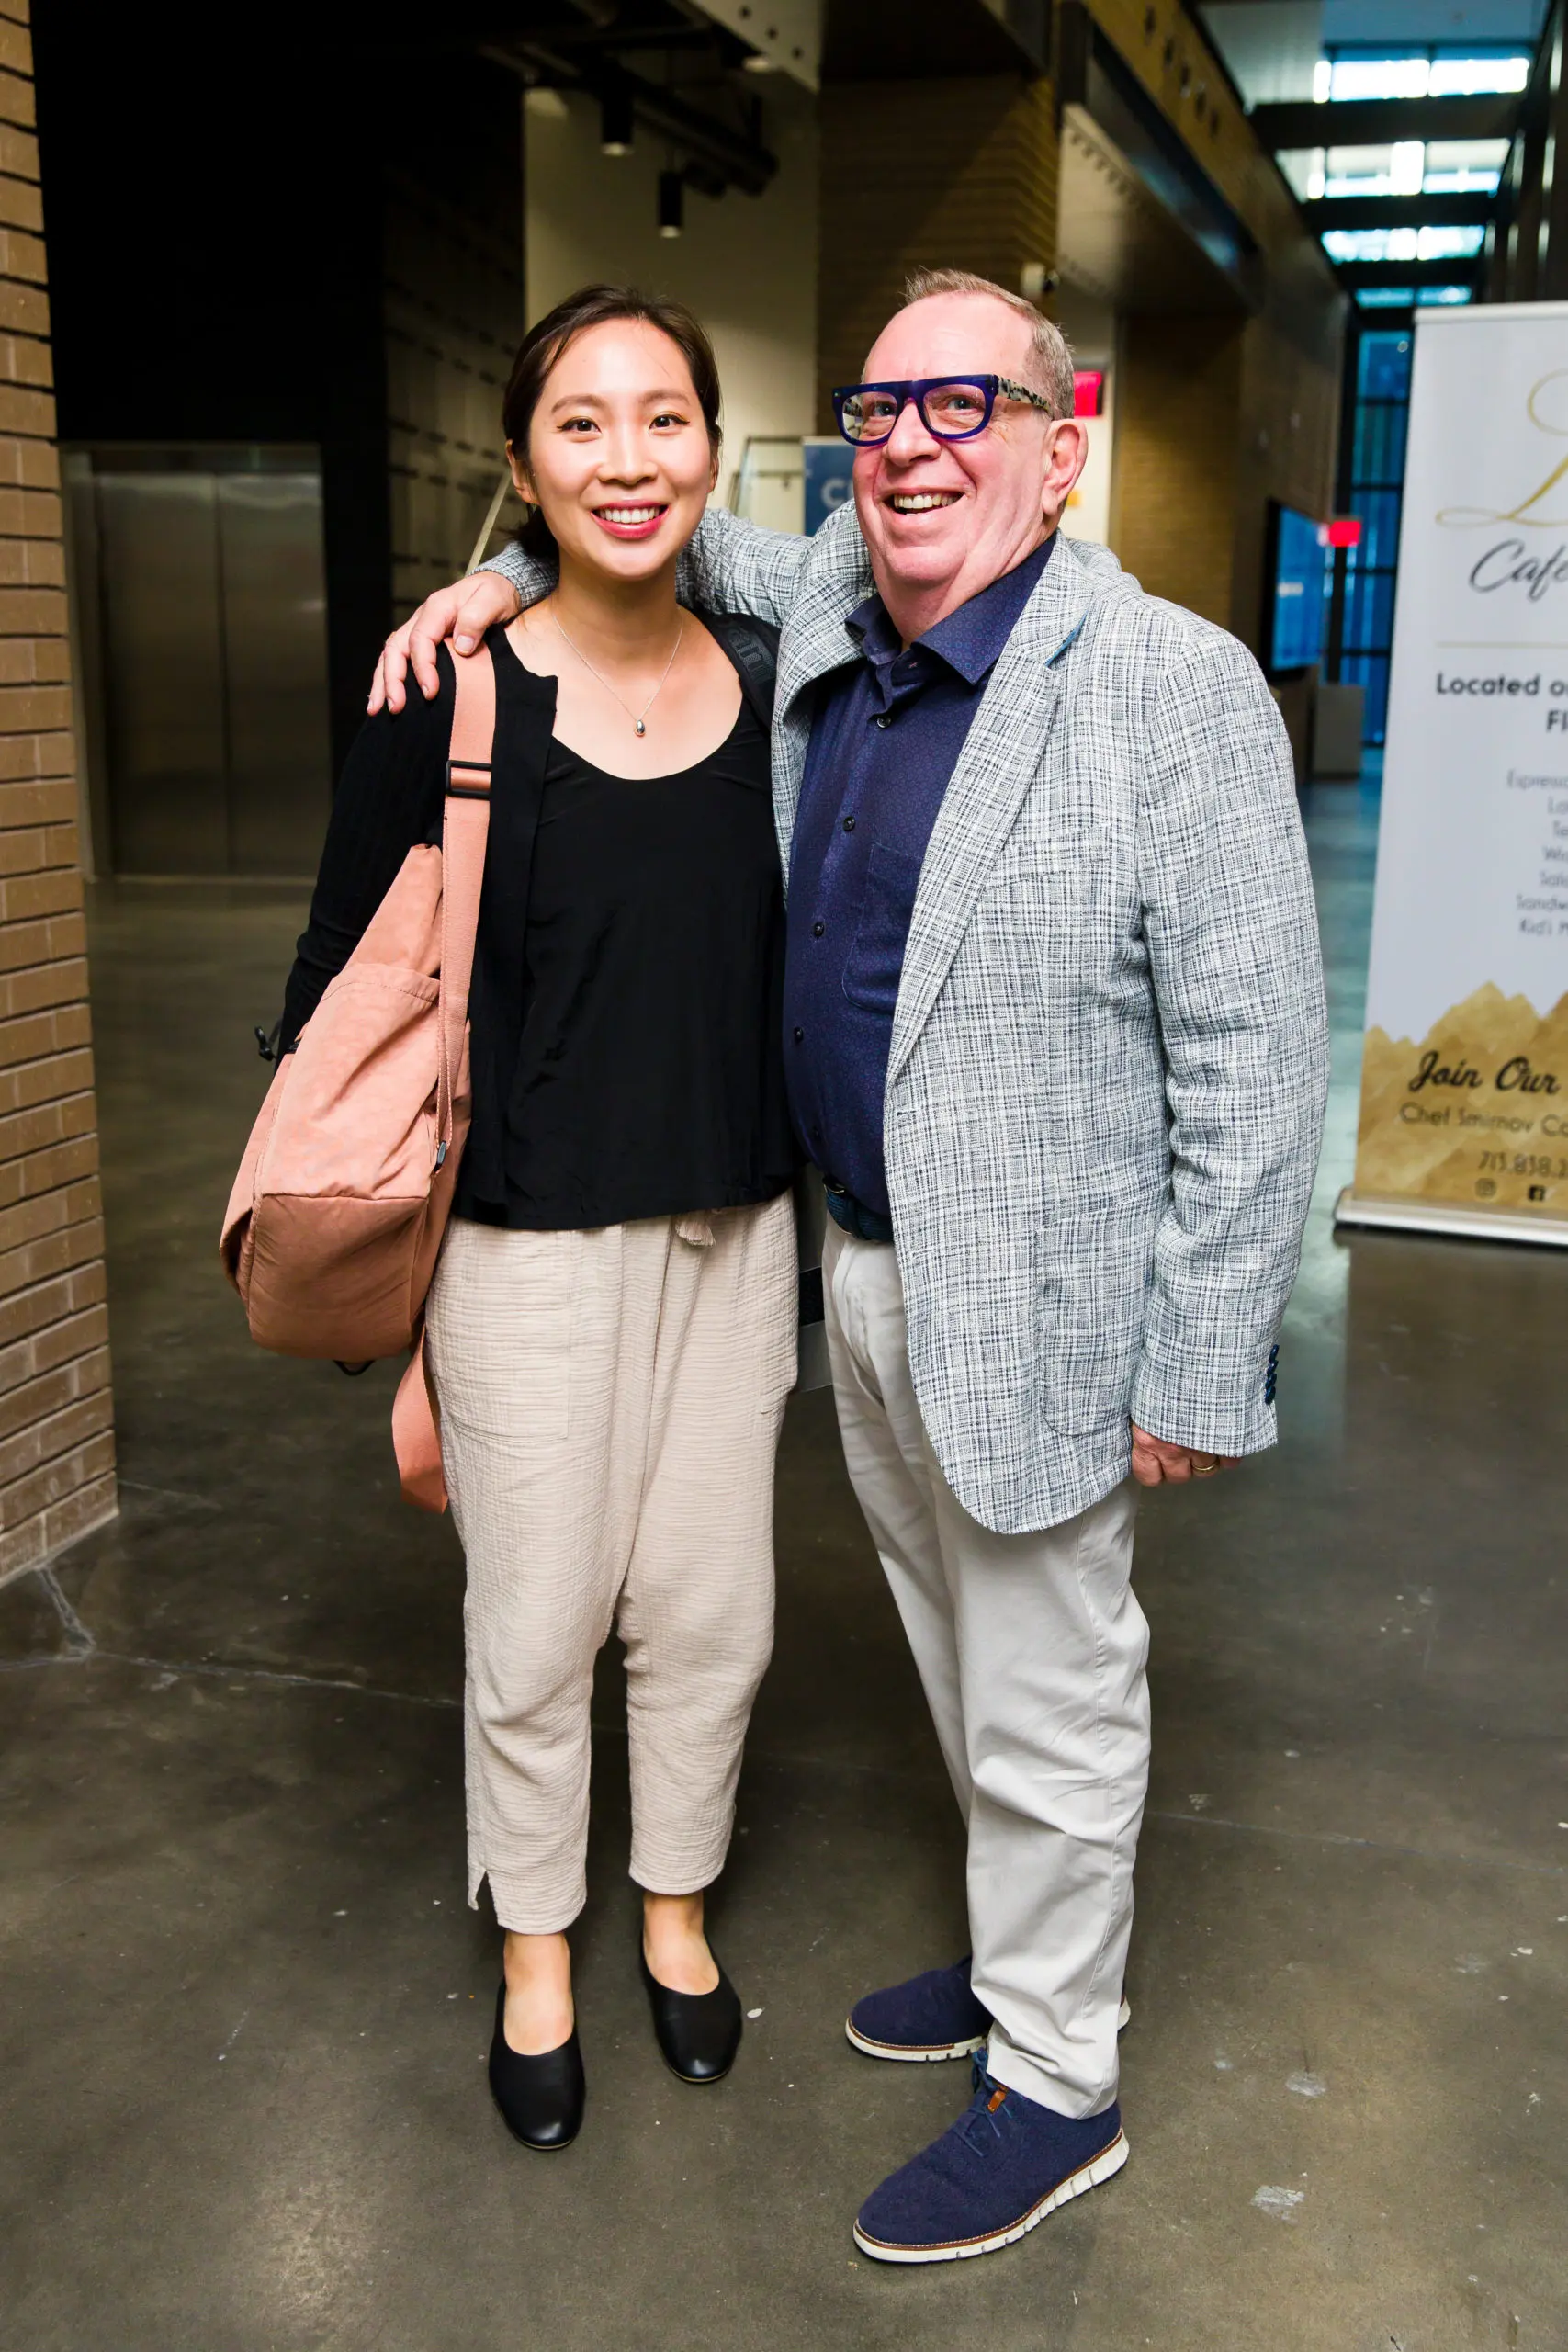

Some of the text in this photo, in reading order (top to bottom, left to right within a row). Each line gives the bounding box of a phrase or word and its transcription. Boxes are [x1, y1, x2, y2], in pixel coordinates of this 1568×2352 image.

[1437, 672, 1540, 695] Located
[1408, 1050, 1561, 1094] Join Our
[1400, 1102, 1450, 1126] Chef
